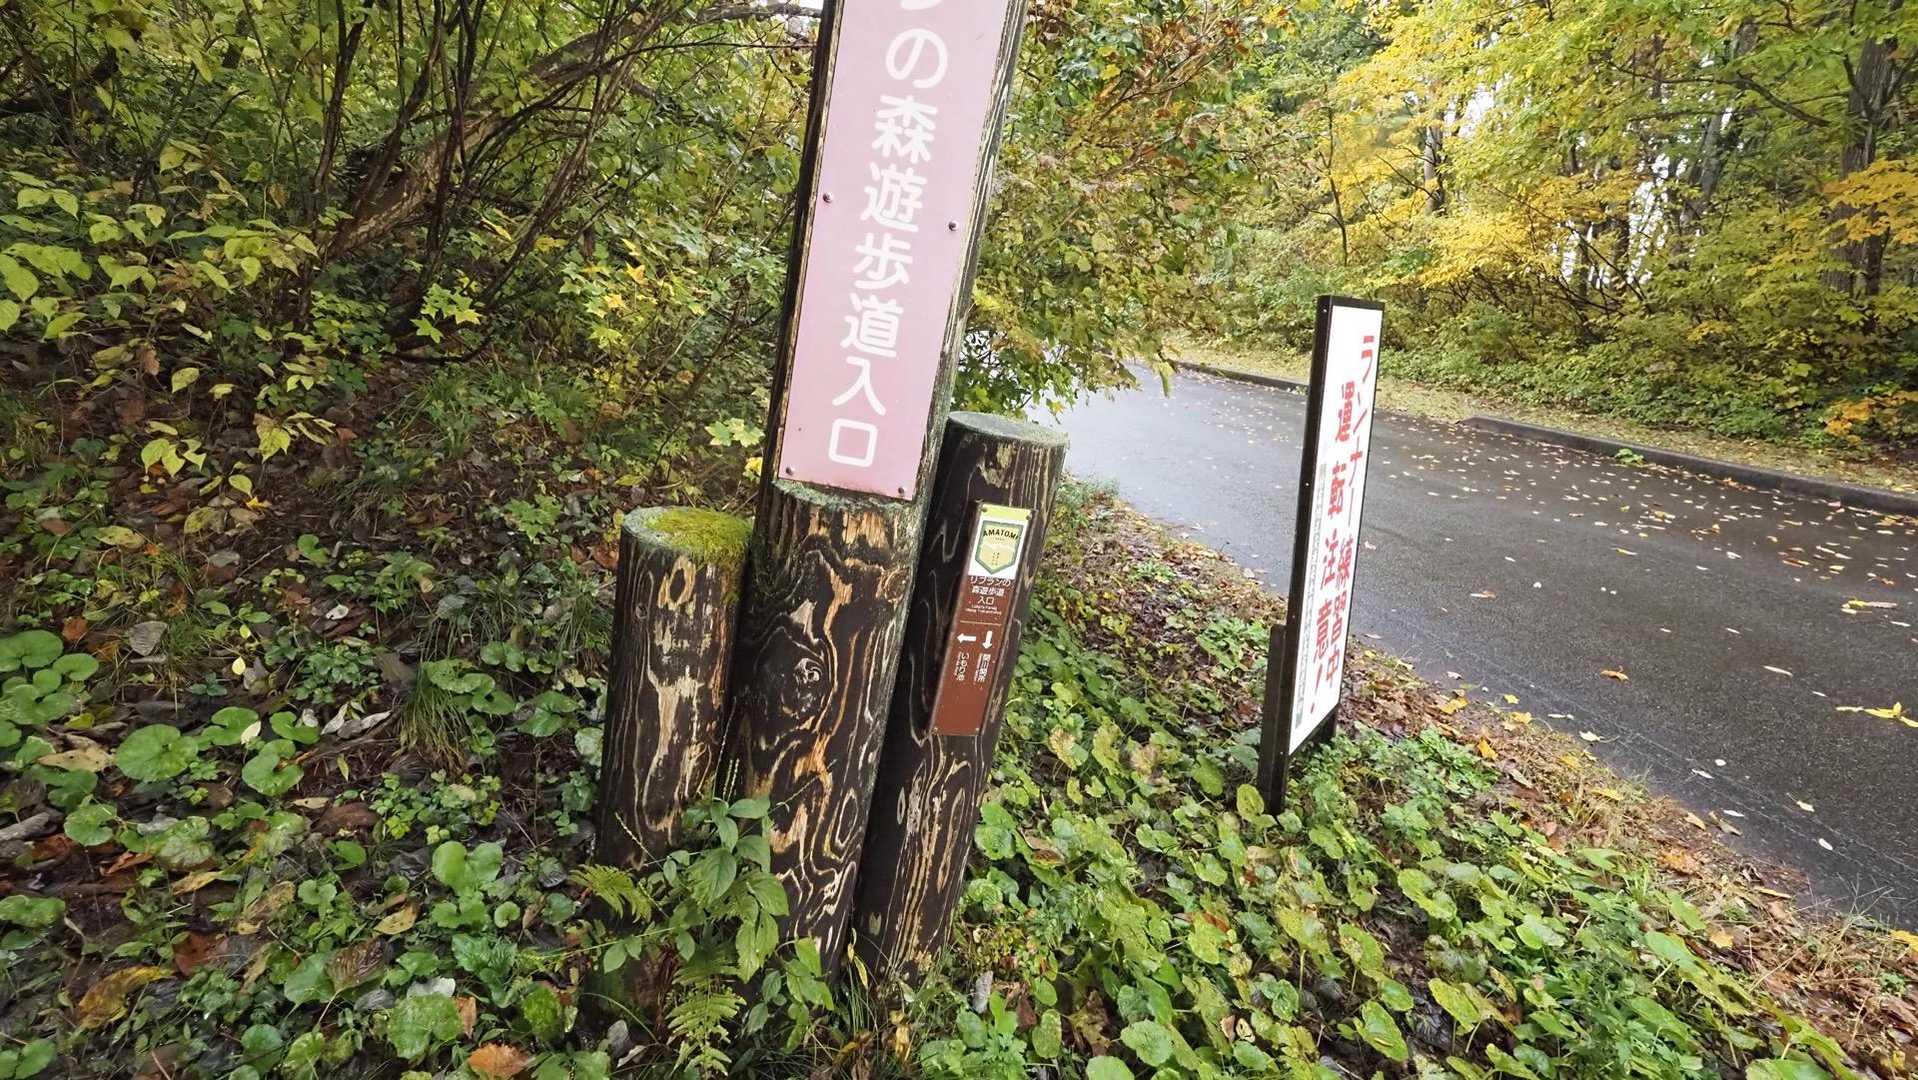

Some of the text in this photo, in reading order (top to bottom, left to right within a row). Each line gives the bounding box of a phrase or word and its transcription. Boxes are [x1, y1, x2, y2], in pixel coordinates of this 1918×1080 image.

[828, 0, 949, 468] の森遊歩道入口
[977, 595, 995, 606] 入口
